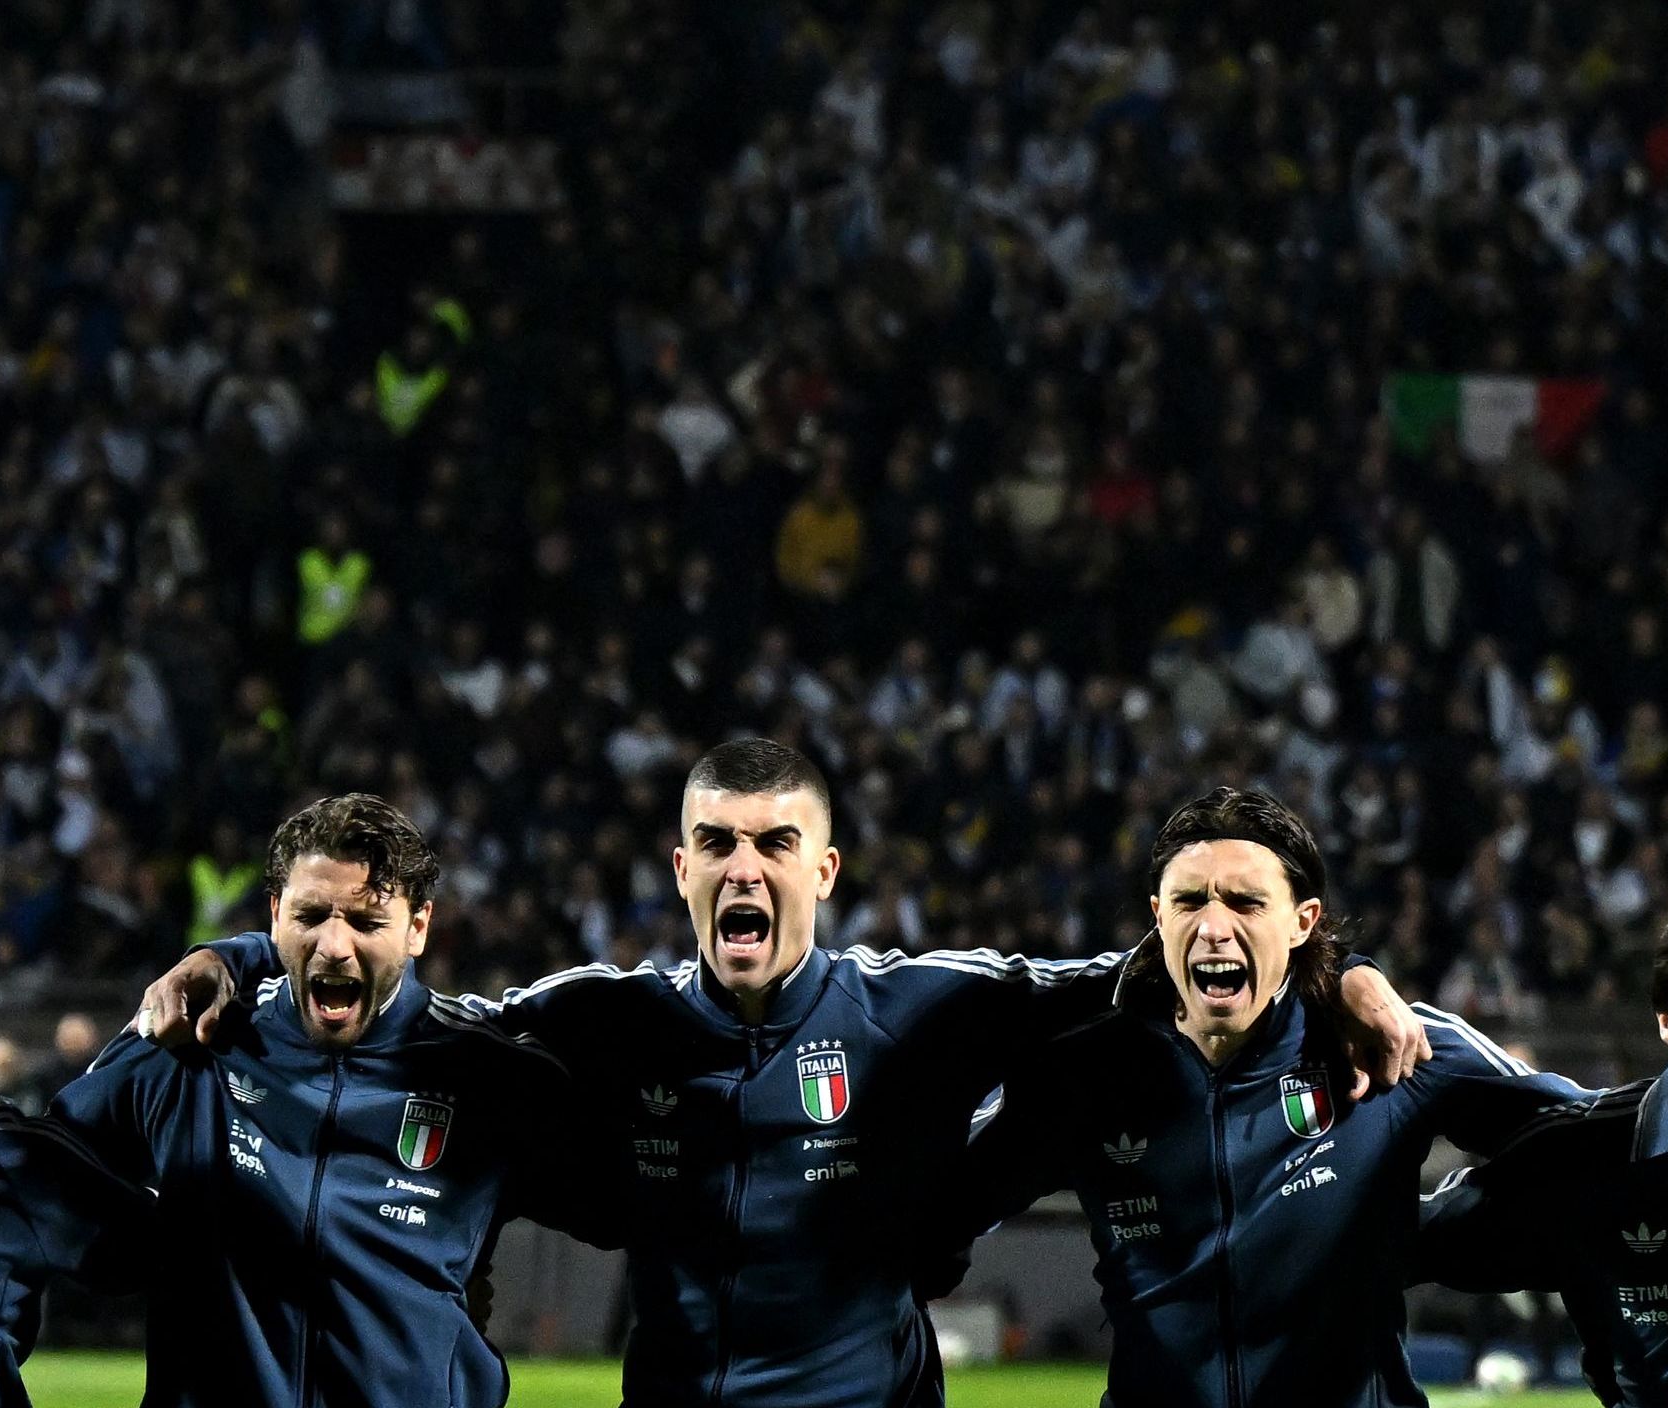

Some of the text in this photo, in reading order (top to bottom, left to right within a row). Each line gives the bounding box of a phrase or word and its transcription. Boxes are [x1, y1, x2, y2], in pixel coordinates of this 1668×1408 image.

[802, 1056, 842, 1075] ITALIA
[1283, 1073, 1322, 1093] ITALIA
[408, 1104, 446, 1123] ITALIA
[651, 1140, 679, 1156] TIM
[813, 1136, 859, 1149] Telepass
[804, 1161, 835, 1182] eni
[396, 1178, 441, 1199] Telepass
[1281, 1171, 1312, 1196] eni
[378, 1203, 409, 1221] eni
[1124, 1195, 1158, 1216] TIM
[1111, 1222, 1161, 1243] Poste
[1635, 1285, 1668, 1302] TIM
[1621, 1307, 1668, 1323] Poste
